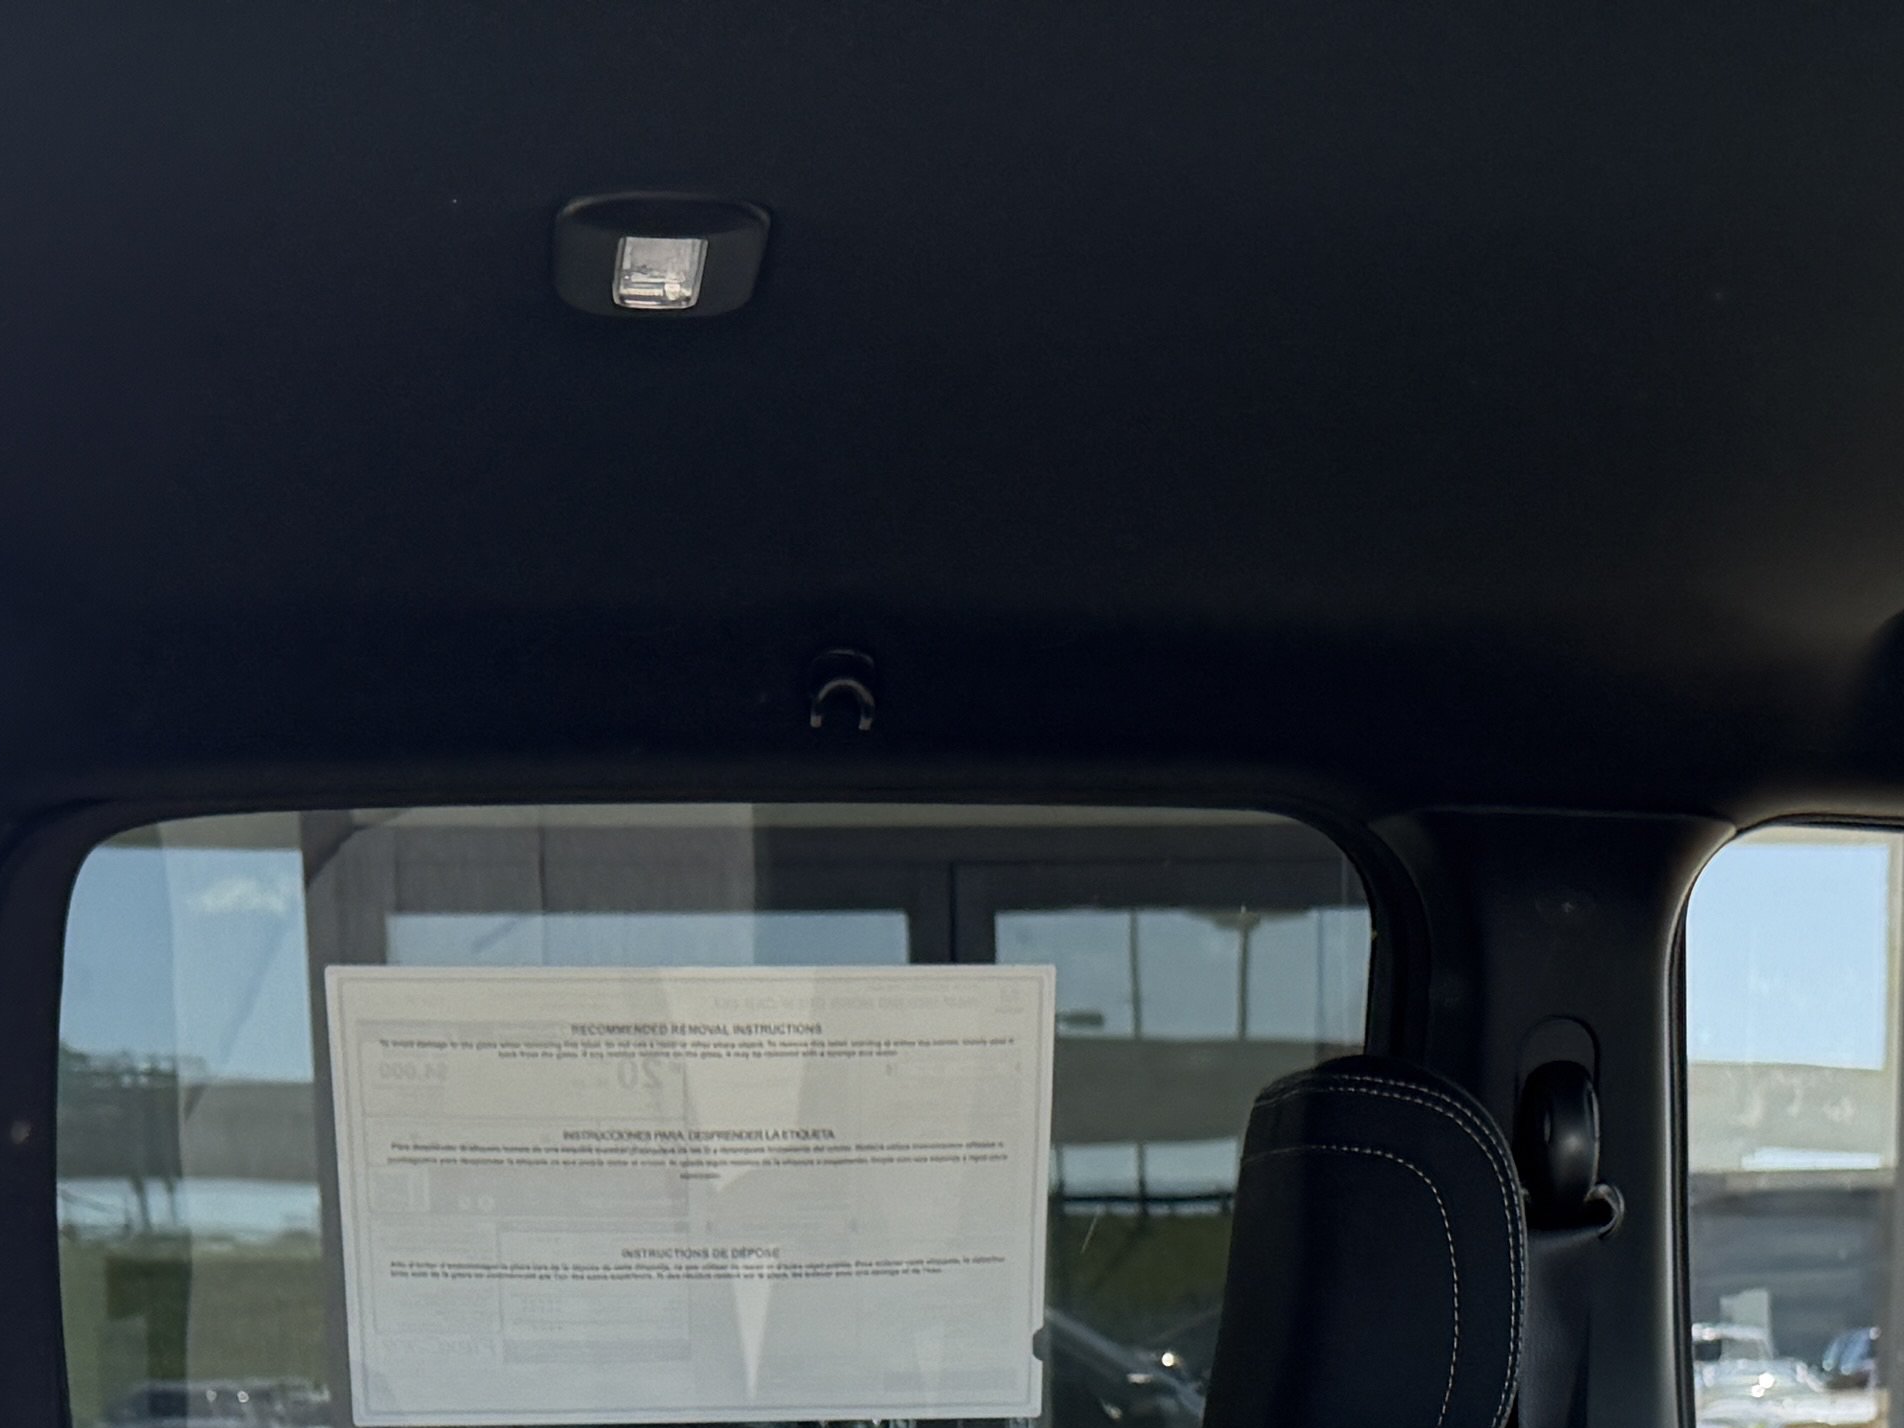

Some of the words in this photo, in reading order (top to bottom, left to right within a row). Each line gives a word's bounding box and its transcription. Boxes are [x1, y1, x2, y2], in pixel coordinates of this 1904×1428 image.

[570, 1023, 668, 1036] RECOMMENDED
[670, 1023, 729, 1036] REMOVAL
[731, 1022, 822, 1036] INSTRUCTIONS
[562, 1129, 651, 1141] INSTRUCCIONES
[653, 1129, 684, 1141] PARA
[687, 1129, 763, 1141] DESPRENDER
[765, 1129, 779, 1141] LA
[781, 1128, 835, 1140] ETIQUETA
[621, 1247, 709, 1259] INSTRUCTIONS
[711, 1248, 729, 1259] DE
[729, 1245, 780, 1259] DÉPOSE
